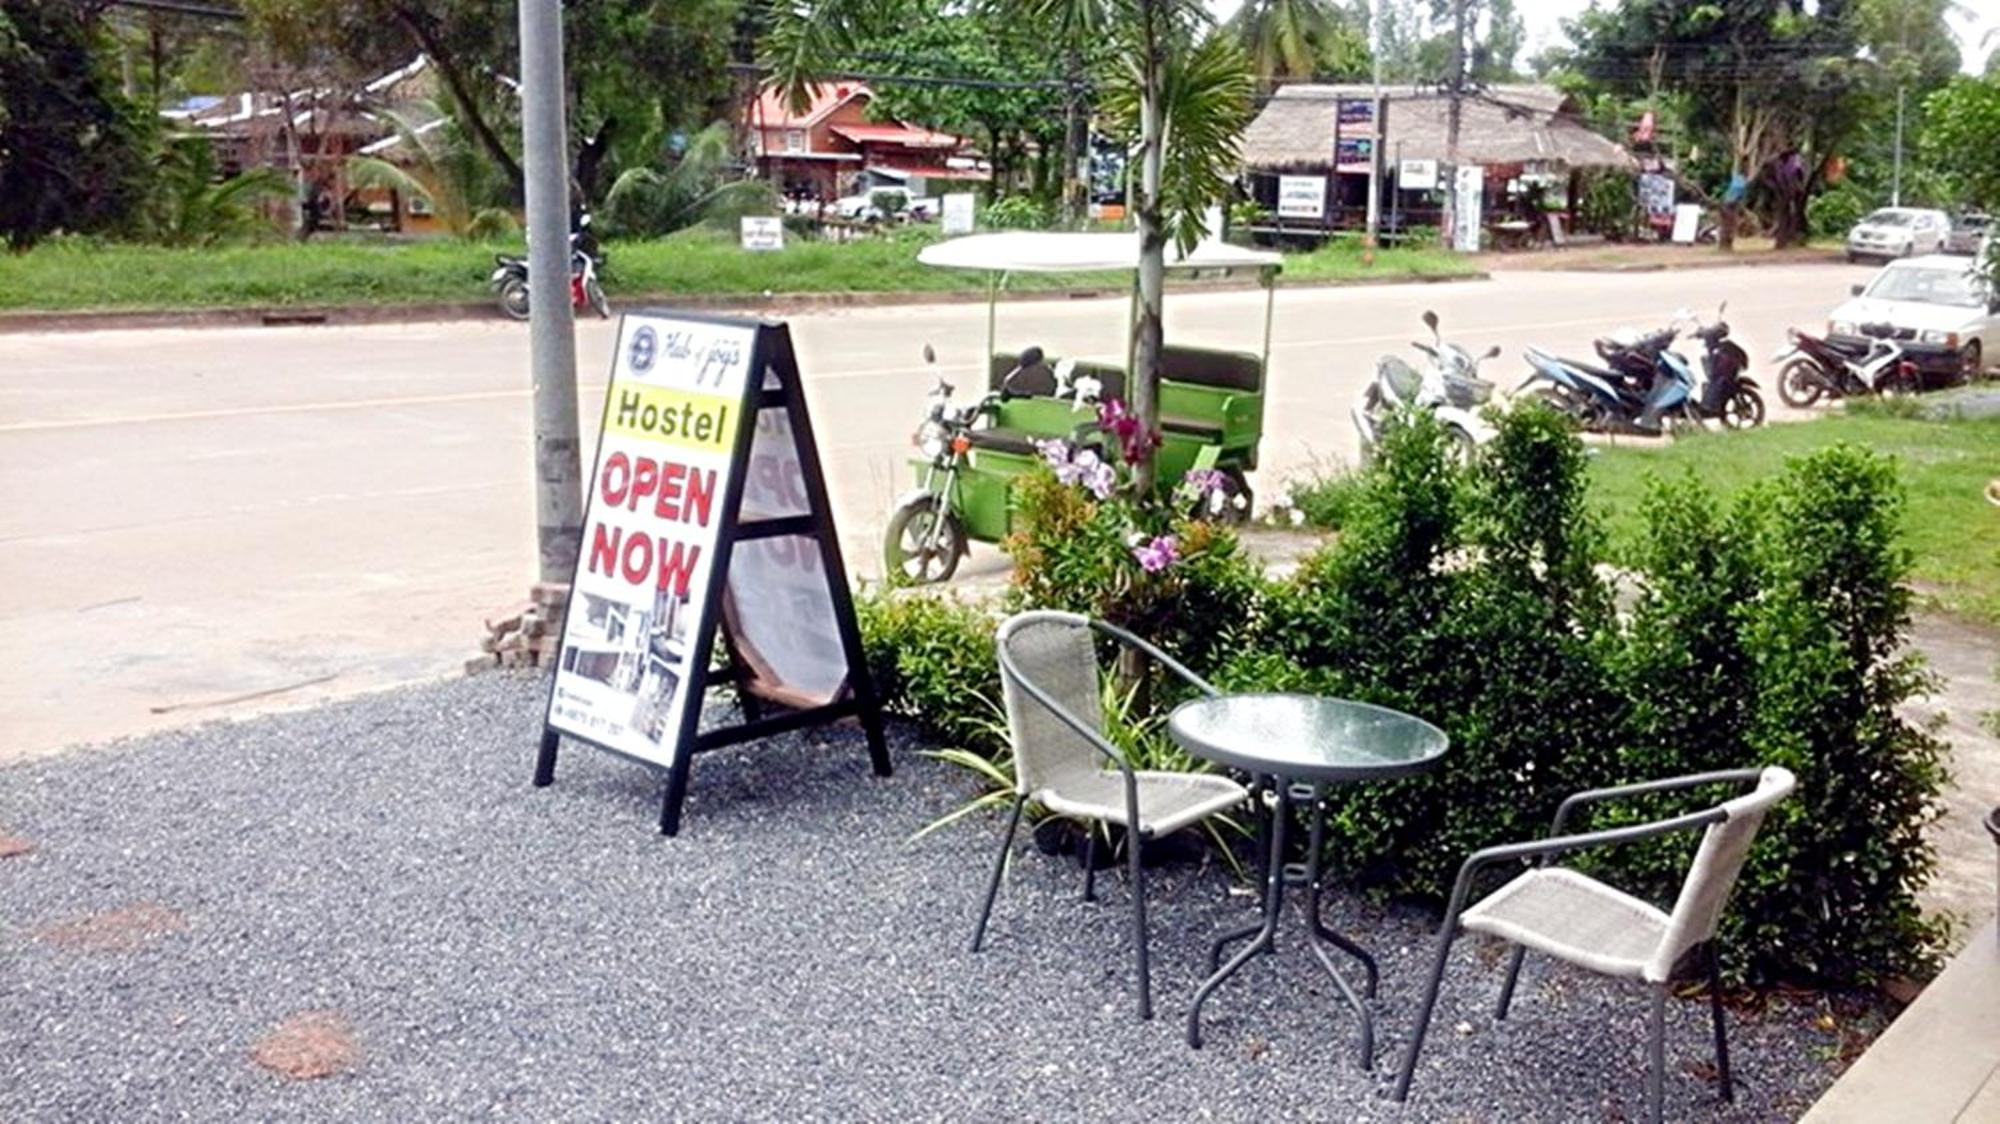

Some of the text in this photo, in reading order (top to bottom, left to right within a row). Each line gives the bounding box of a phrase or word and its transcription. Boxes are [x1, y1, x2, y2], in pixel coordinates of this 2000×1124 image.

[617, 389, 727, 444] Hostel
[600, 451, 717, 528] OPEN
[588, 522, 702, 598] NOW
